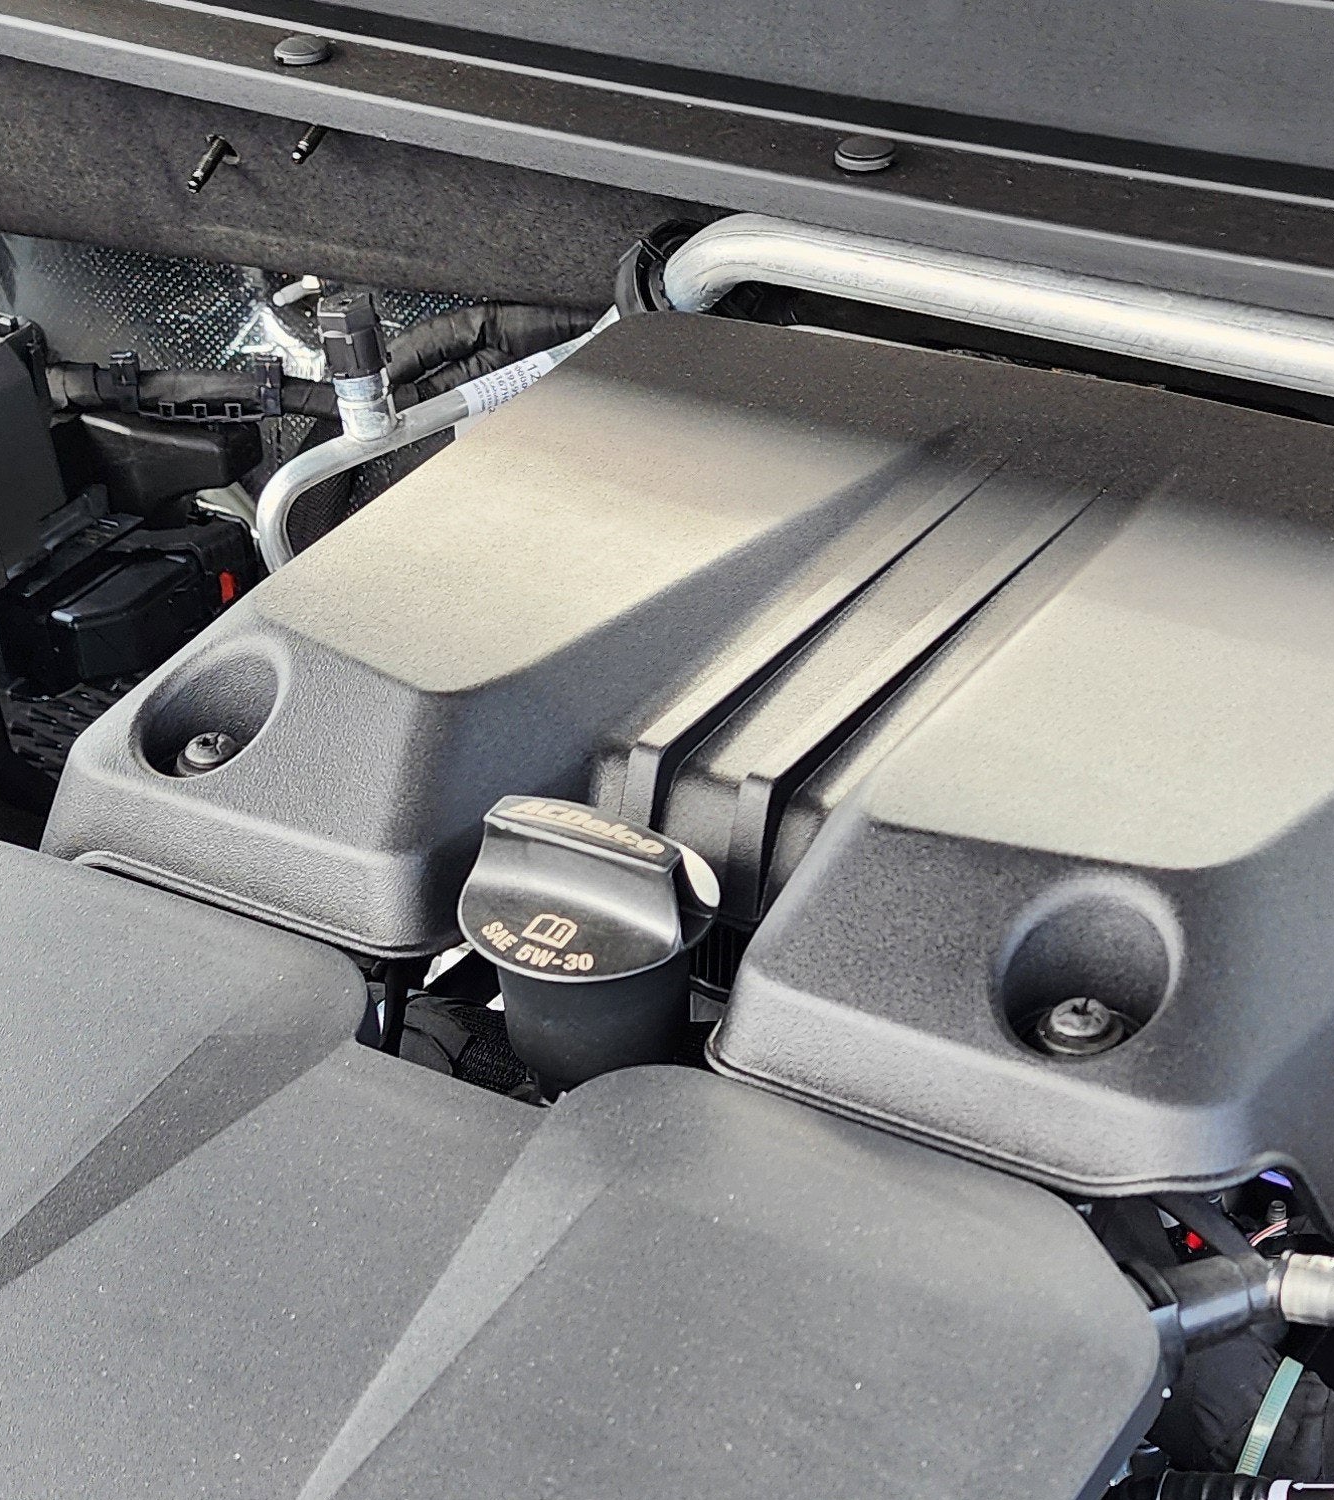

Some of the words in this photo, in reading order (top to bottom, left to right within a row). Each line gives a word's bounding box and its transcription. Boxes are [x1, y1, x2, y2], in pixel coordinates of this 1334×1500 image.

[496, 800, 666, 855] ACDelco
[481, 920, 519, 952] SAE
[514, 942, 595, 972] 5W-30
